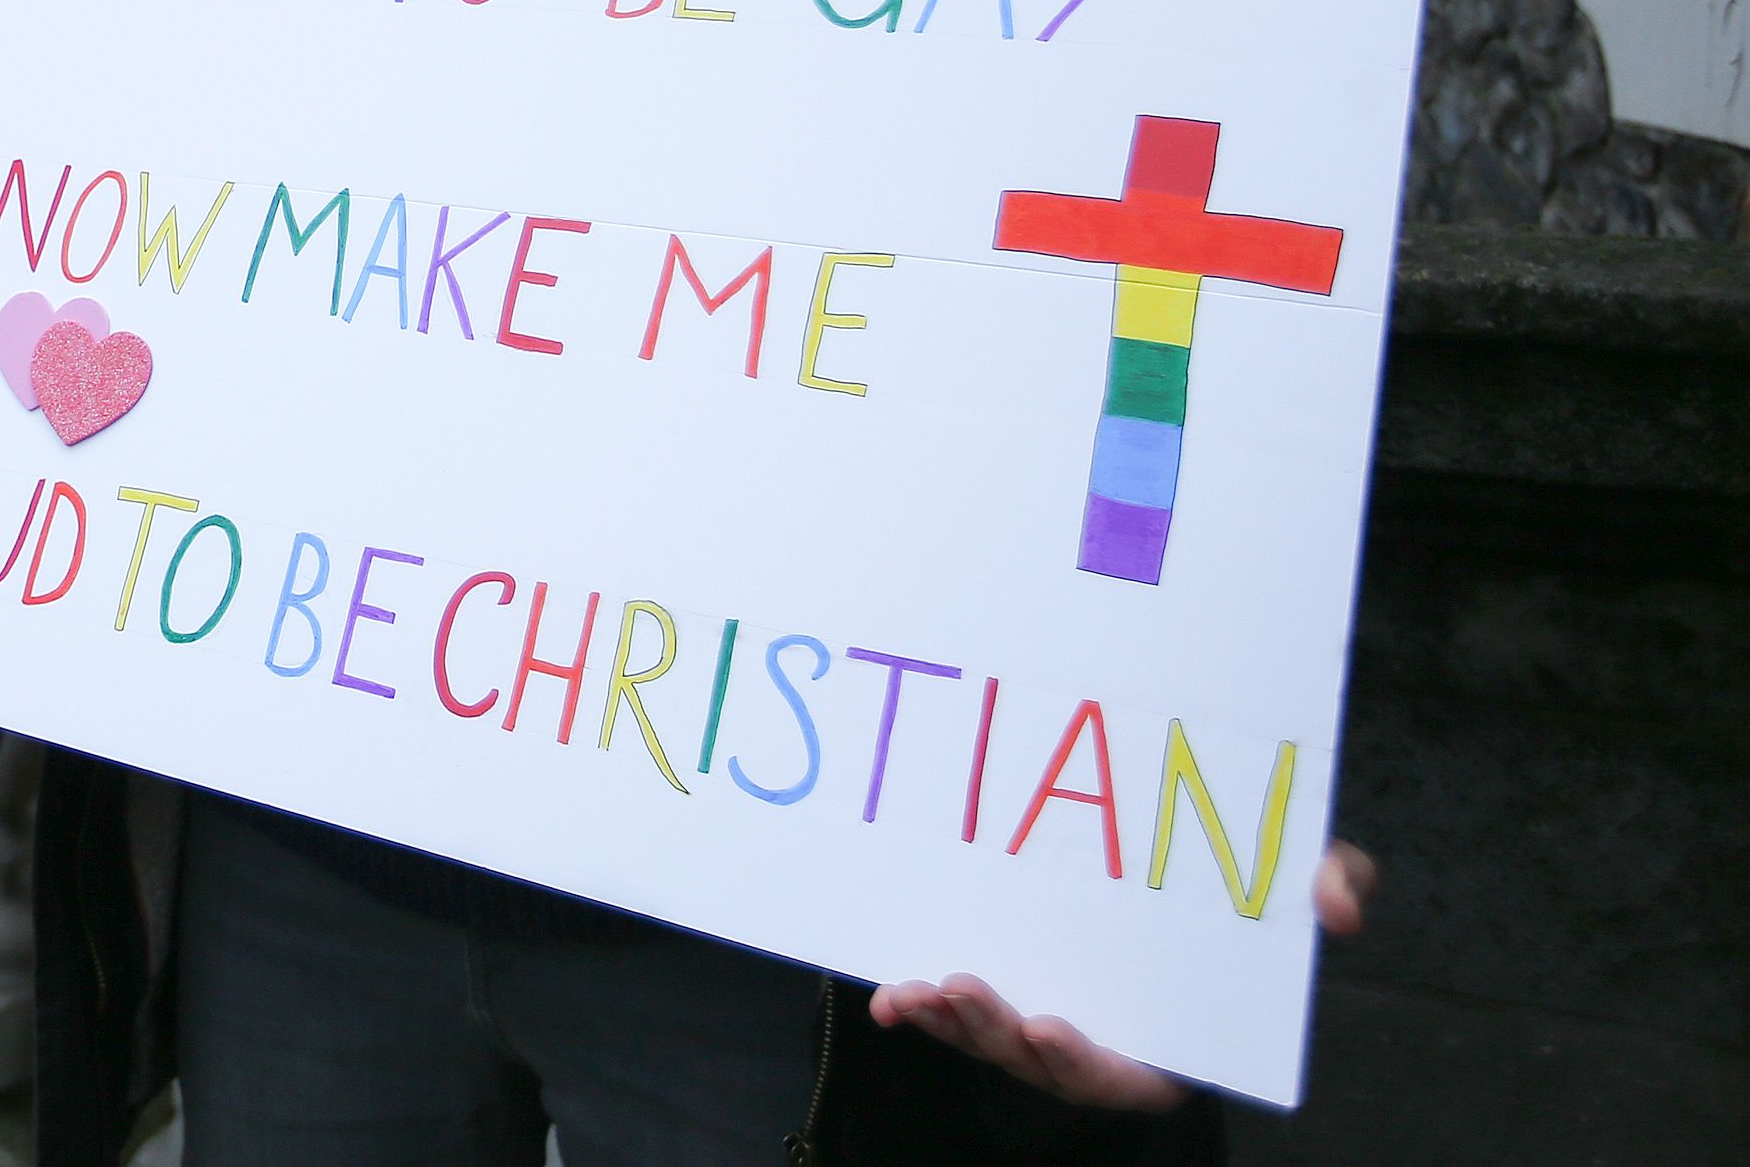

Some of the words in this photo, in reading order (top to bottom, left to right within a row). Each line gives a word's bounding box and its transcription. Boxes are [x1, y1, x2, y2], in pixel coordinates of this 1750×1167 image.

[241, 181, 592, 356] MAKE
[637, 233, 895, 397] ME
[114, 486, 243, 644] TO
[264, 531, 424, 700] BE
[433, 571, 1296, 920] CHRISTIAN
